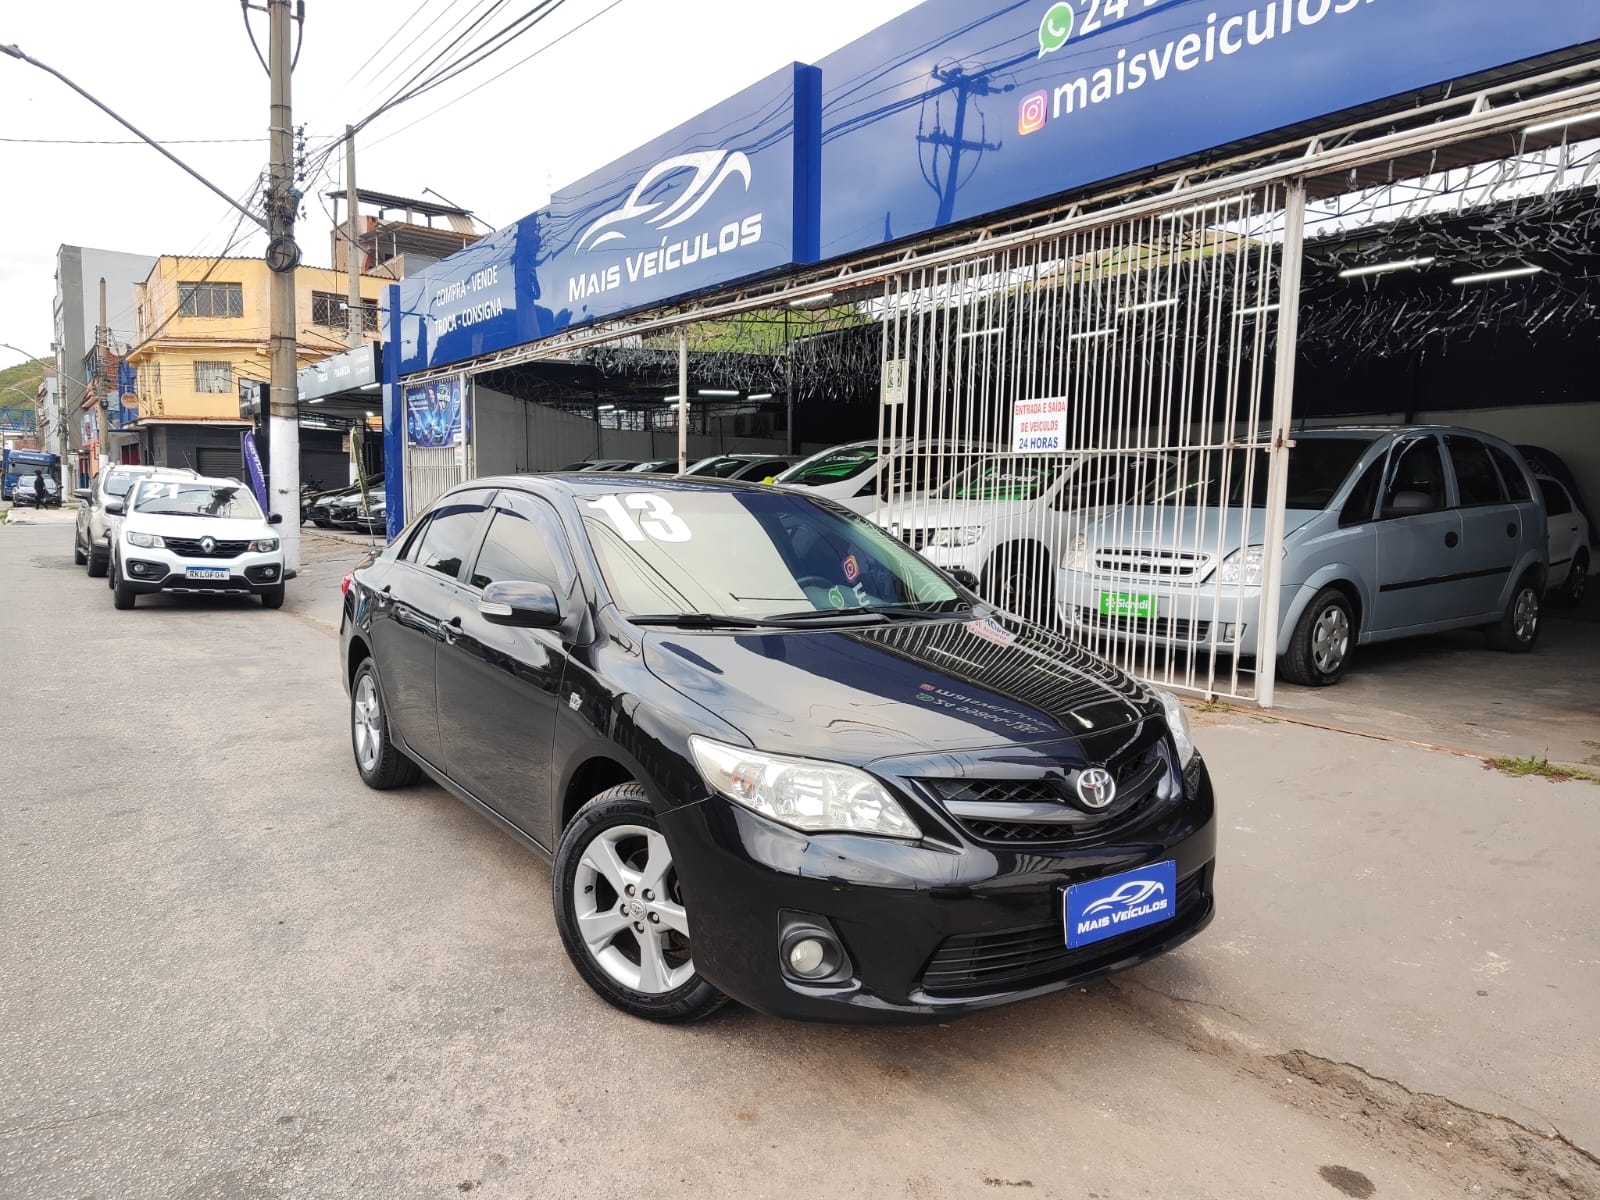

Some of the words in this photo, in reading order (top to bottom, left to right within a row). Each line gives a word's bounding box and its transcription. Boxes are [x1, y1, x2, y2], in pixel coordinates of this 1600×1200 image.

[1053, 0, 1375, 119] maisveiculo
[568, 265, 621, 302] MAIS
[626, 212, 762, 283] VEÍCULOS
[436, 280, 466, 307] COMPRA
[472, 265, 498, 292] VENDE
[434, 313, 458, 336] TROCA
[462, 297, 503, 328] CONSIGNA
[1015, 403, 1041, 416] ENTRADA
[1043, 402, 1047, 413] E
[1021, 422, 1028, 432] DE
[1019, 437, 1028, 449] 24
[1030, 436, 1058, 449] HORAS
[142, 482, 180, 499] 21
[587, 493, 692, 543] 13
[1077, 917, 1110, 934] MAIS
[1112, 899, 1168, 924] VEÍCULOS
